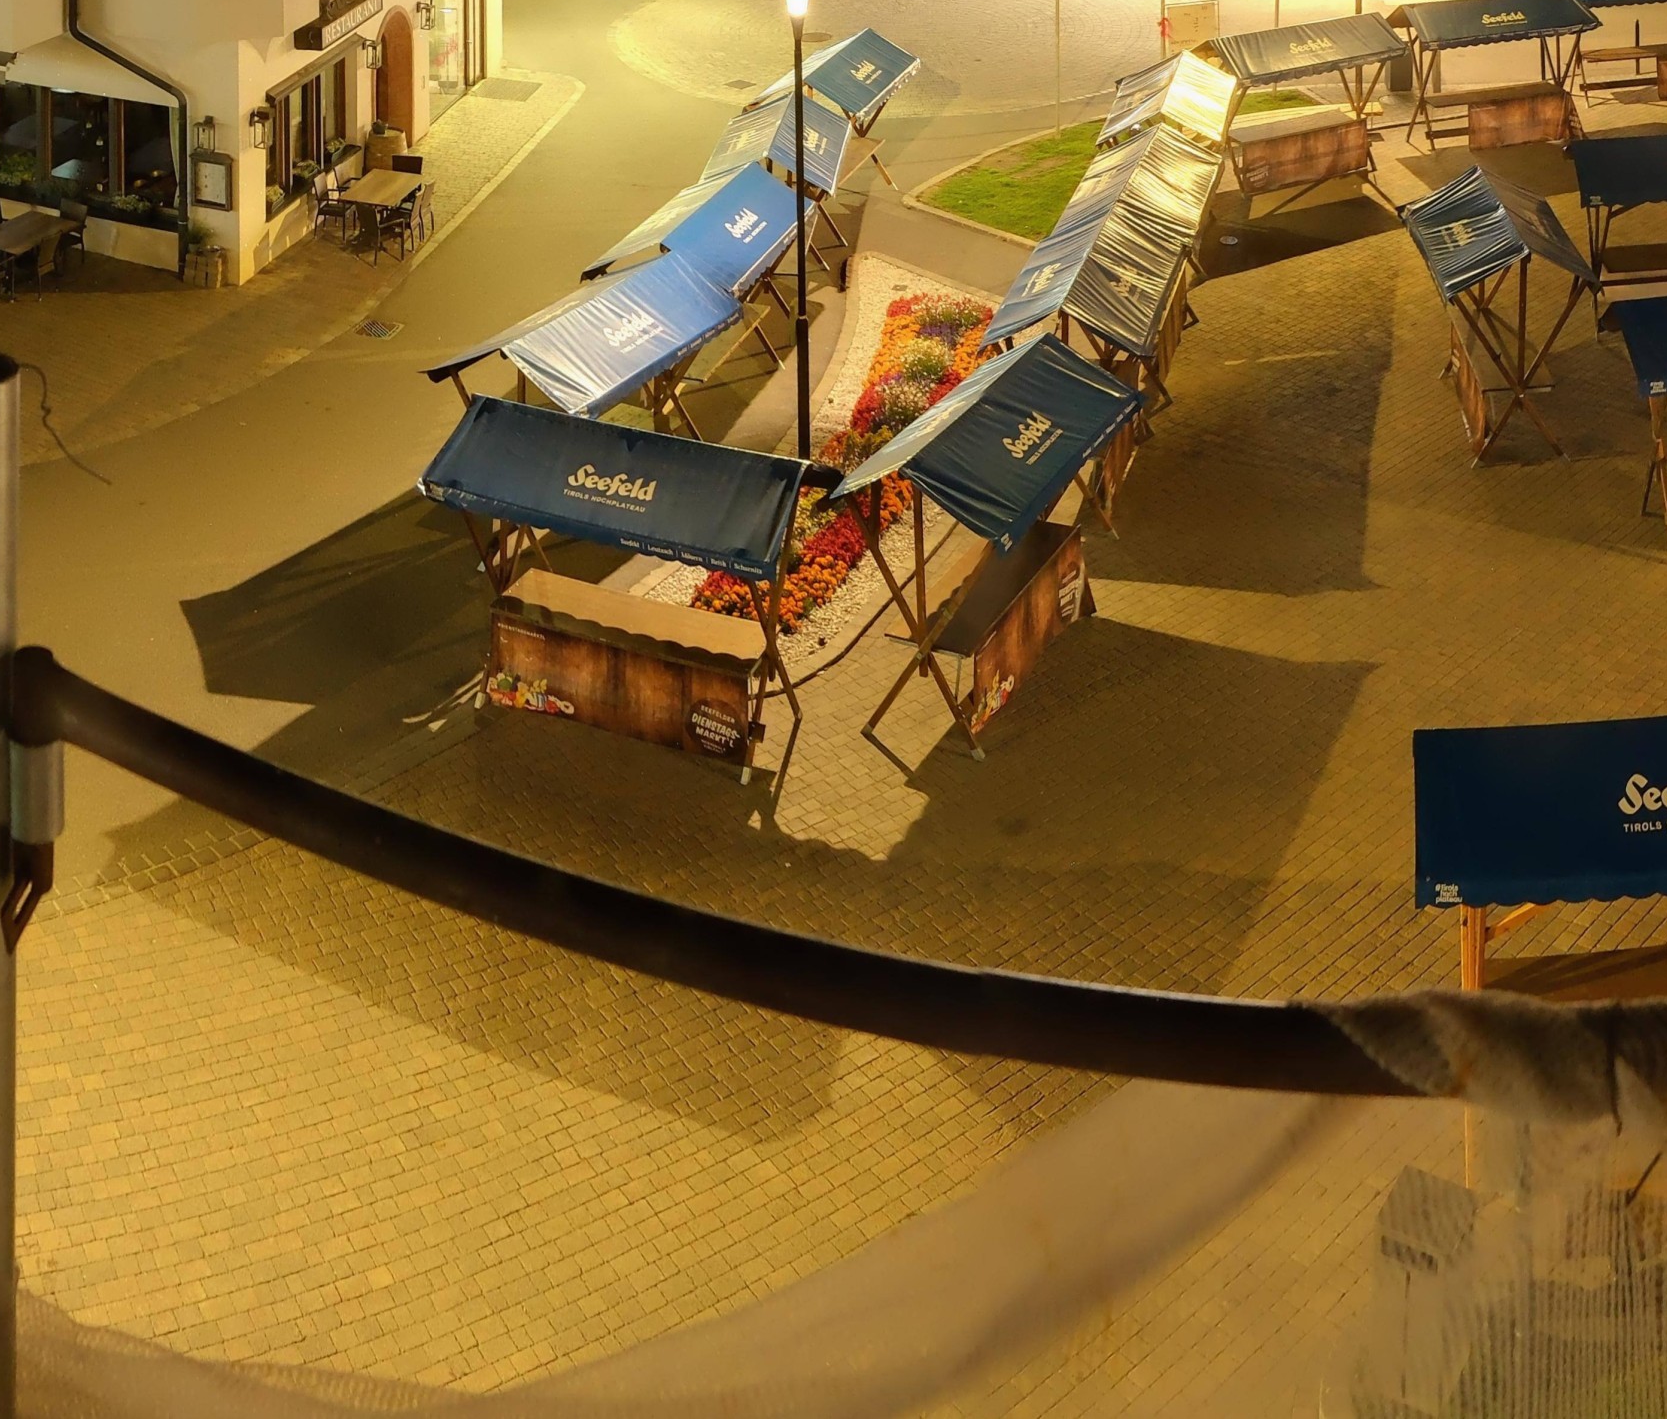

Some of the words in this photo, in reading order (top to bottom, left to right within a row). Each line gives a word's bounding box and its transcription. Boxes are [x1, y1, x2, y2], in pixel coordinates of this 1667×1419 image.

[1481, 10, 1526, 26] Seefeld
[724, 207, 759, 239] Seefeld
[603, 306, 655, 348] Seefeld
[1001, 410, 1053, 461] Seefeld
[563, 488, 590, 501] TIROLS
[567, 463, 658, 503] Seefeld
[1623, 820, 1663, 834] TIROLS
